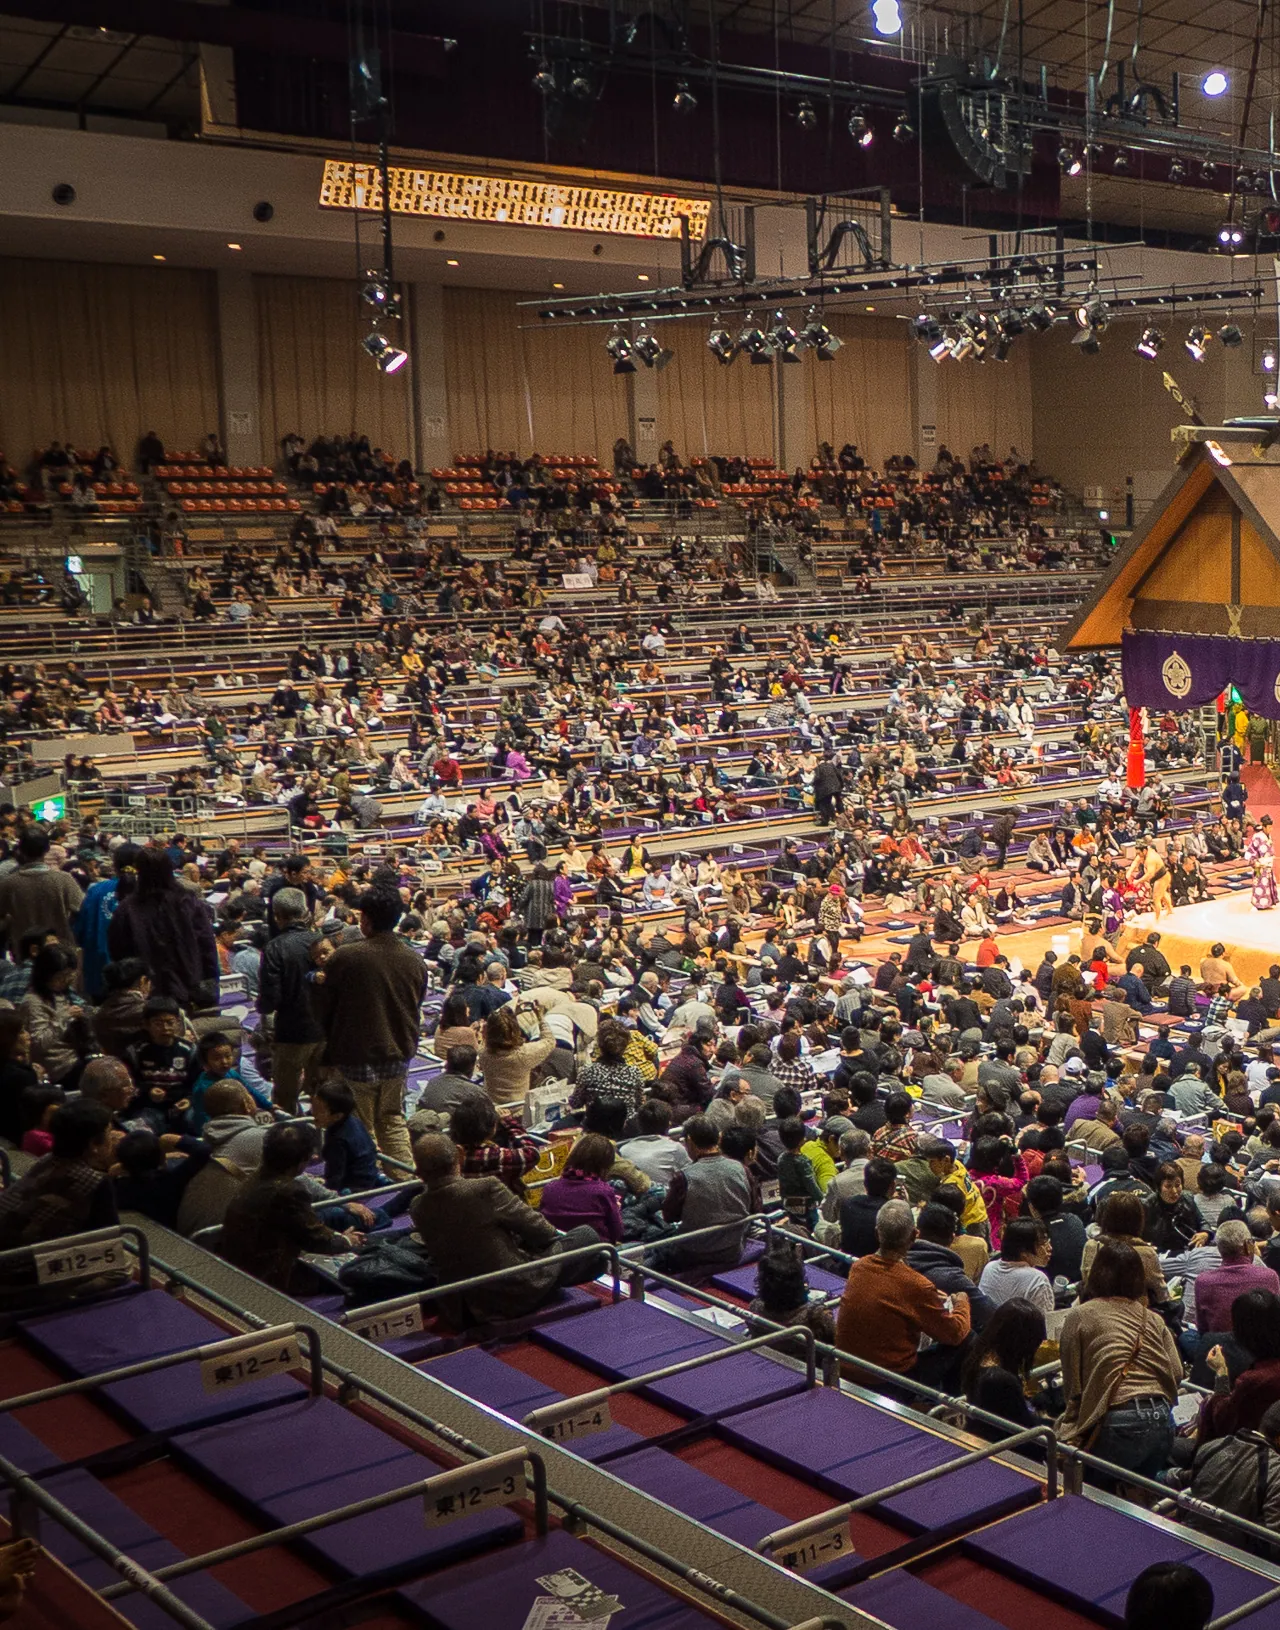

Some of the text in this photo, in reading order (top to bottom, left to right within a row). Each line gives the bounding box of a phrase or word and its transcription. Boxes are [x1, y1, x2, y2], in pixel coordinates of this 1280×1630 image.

[46, 1248, 116, 1276] 東12-5
[214, 1347, 291, 1384] 東12-4
[435, 1476, 516, 1518] 東12-3
